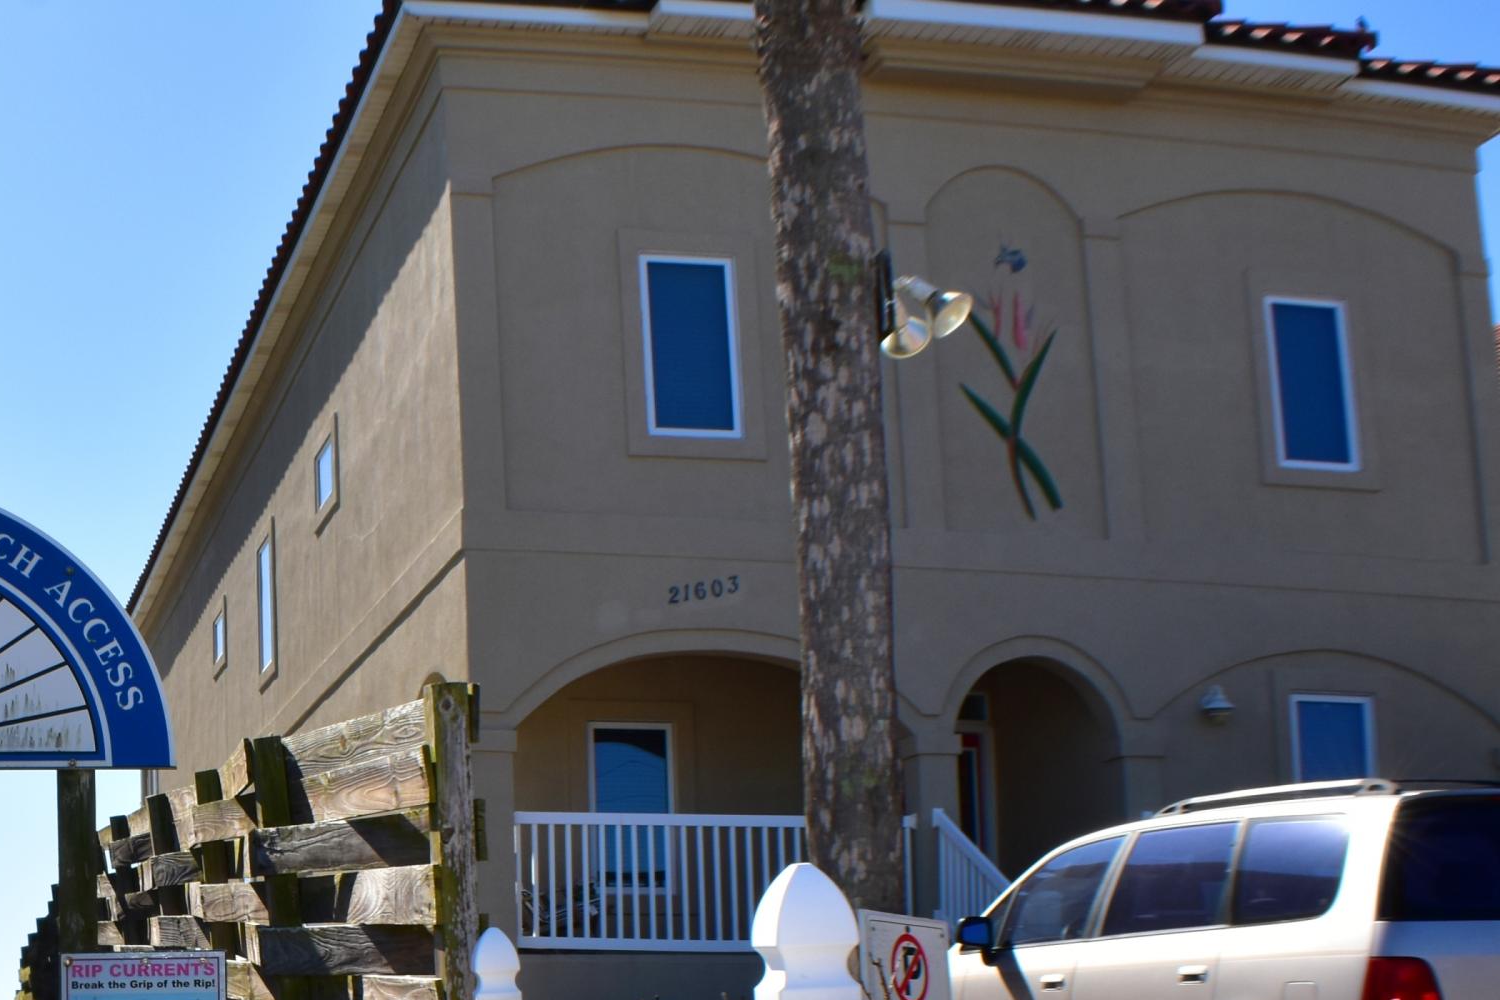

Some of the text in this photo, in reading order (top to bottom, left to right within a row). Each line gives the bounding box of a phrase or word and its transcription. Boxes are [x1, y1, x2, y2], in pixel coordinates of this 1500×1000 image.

[668, 575, 740, 604] 21603
[43, 580, 145, 711] ACCESS
[71, 962, 215, 977] RIP CURRENTS
[71, 979, 215, 990] Break the Grip of the Rip!
